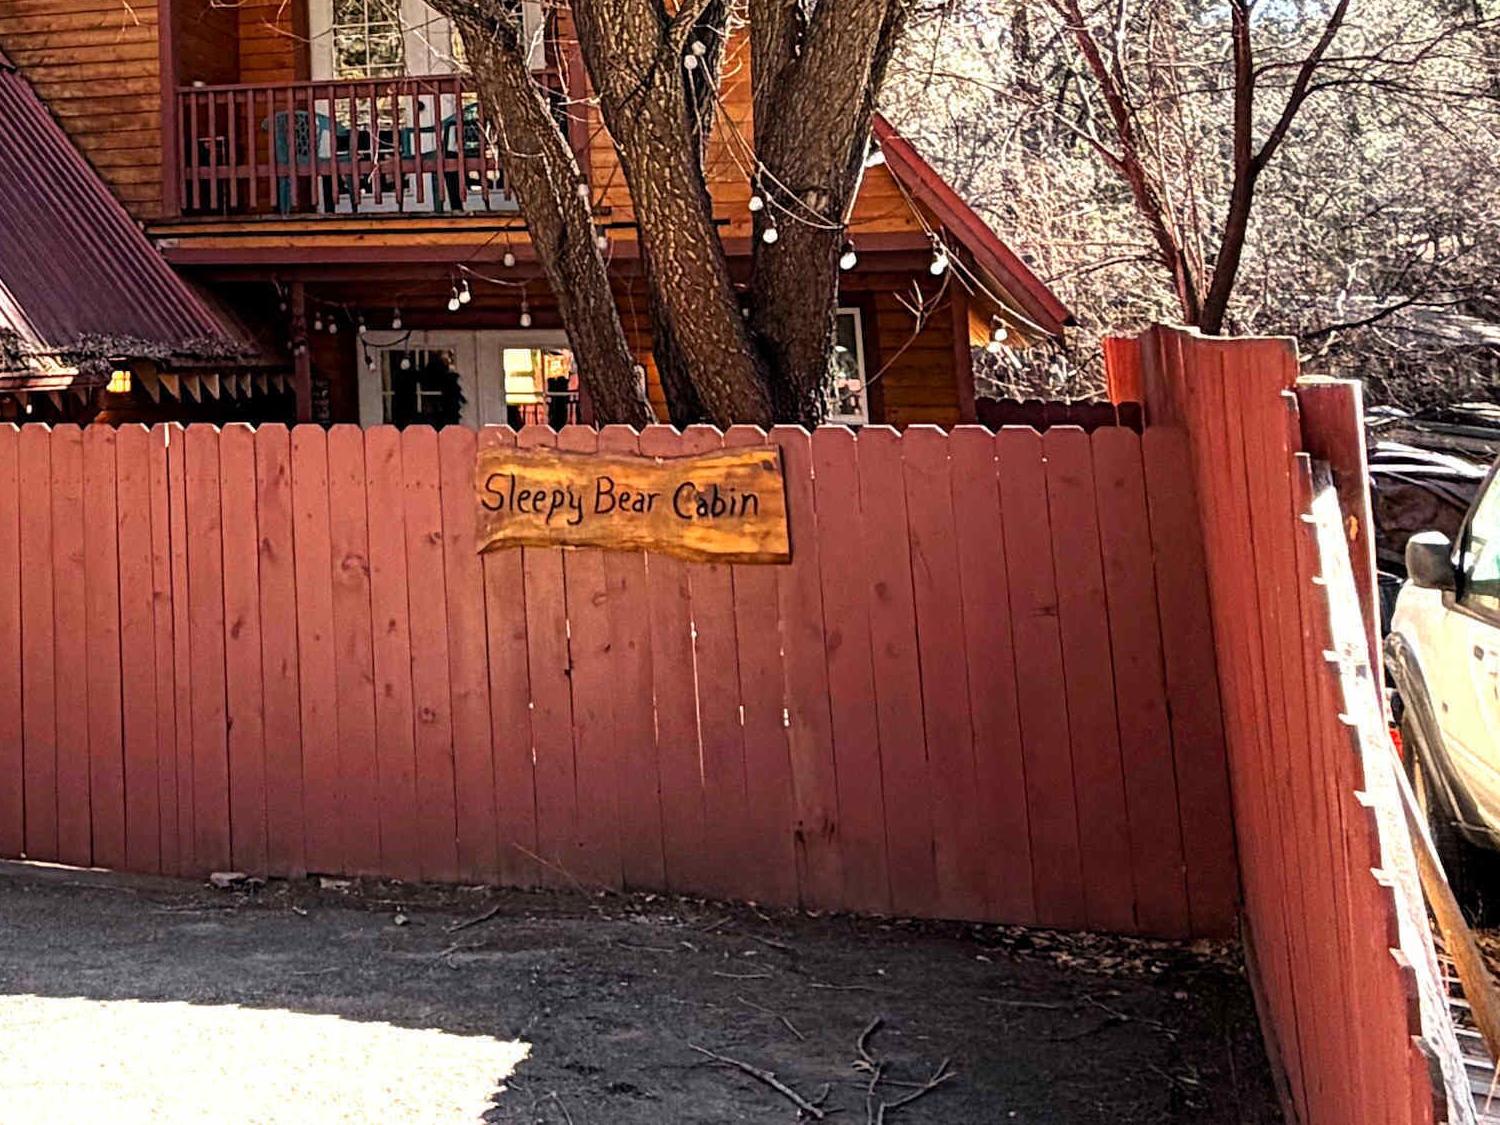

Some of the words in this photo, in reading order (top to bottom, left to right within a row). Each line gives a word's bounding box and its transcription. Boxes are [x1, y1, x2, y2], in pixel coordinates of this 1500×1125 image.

[481, 472, 583, 525] Sleepy
[594, 475, 660, 515] Bear
[672, 481, 759, 520] Cabin
